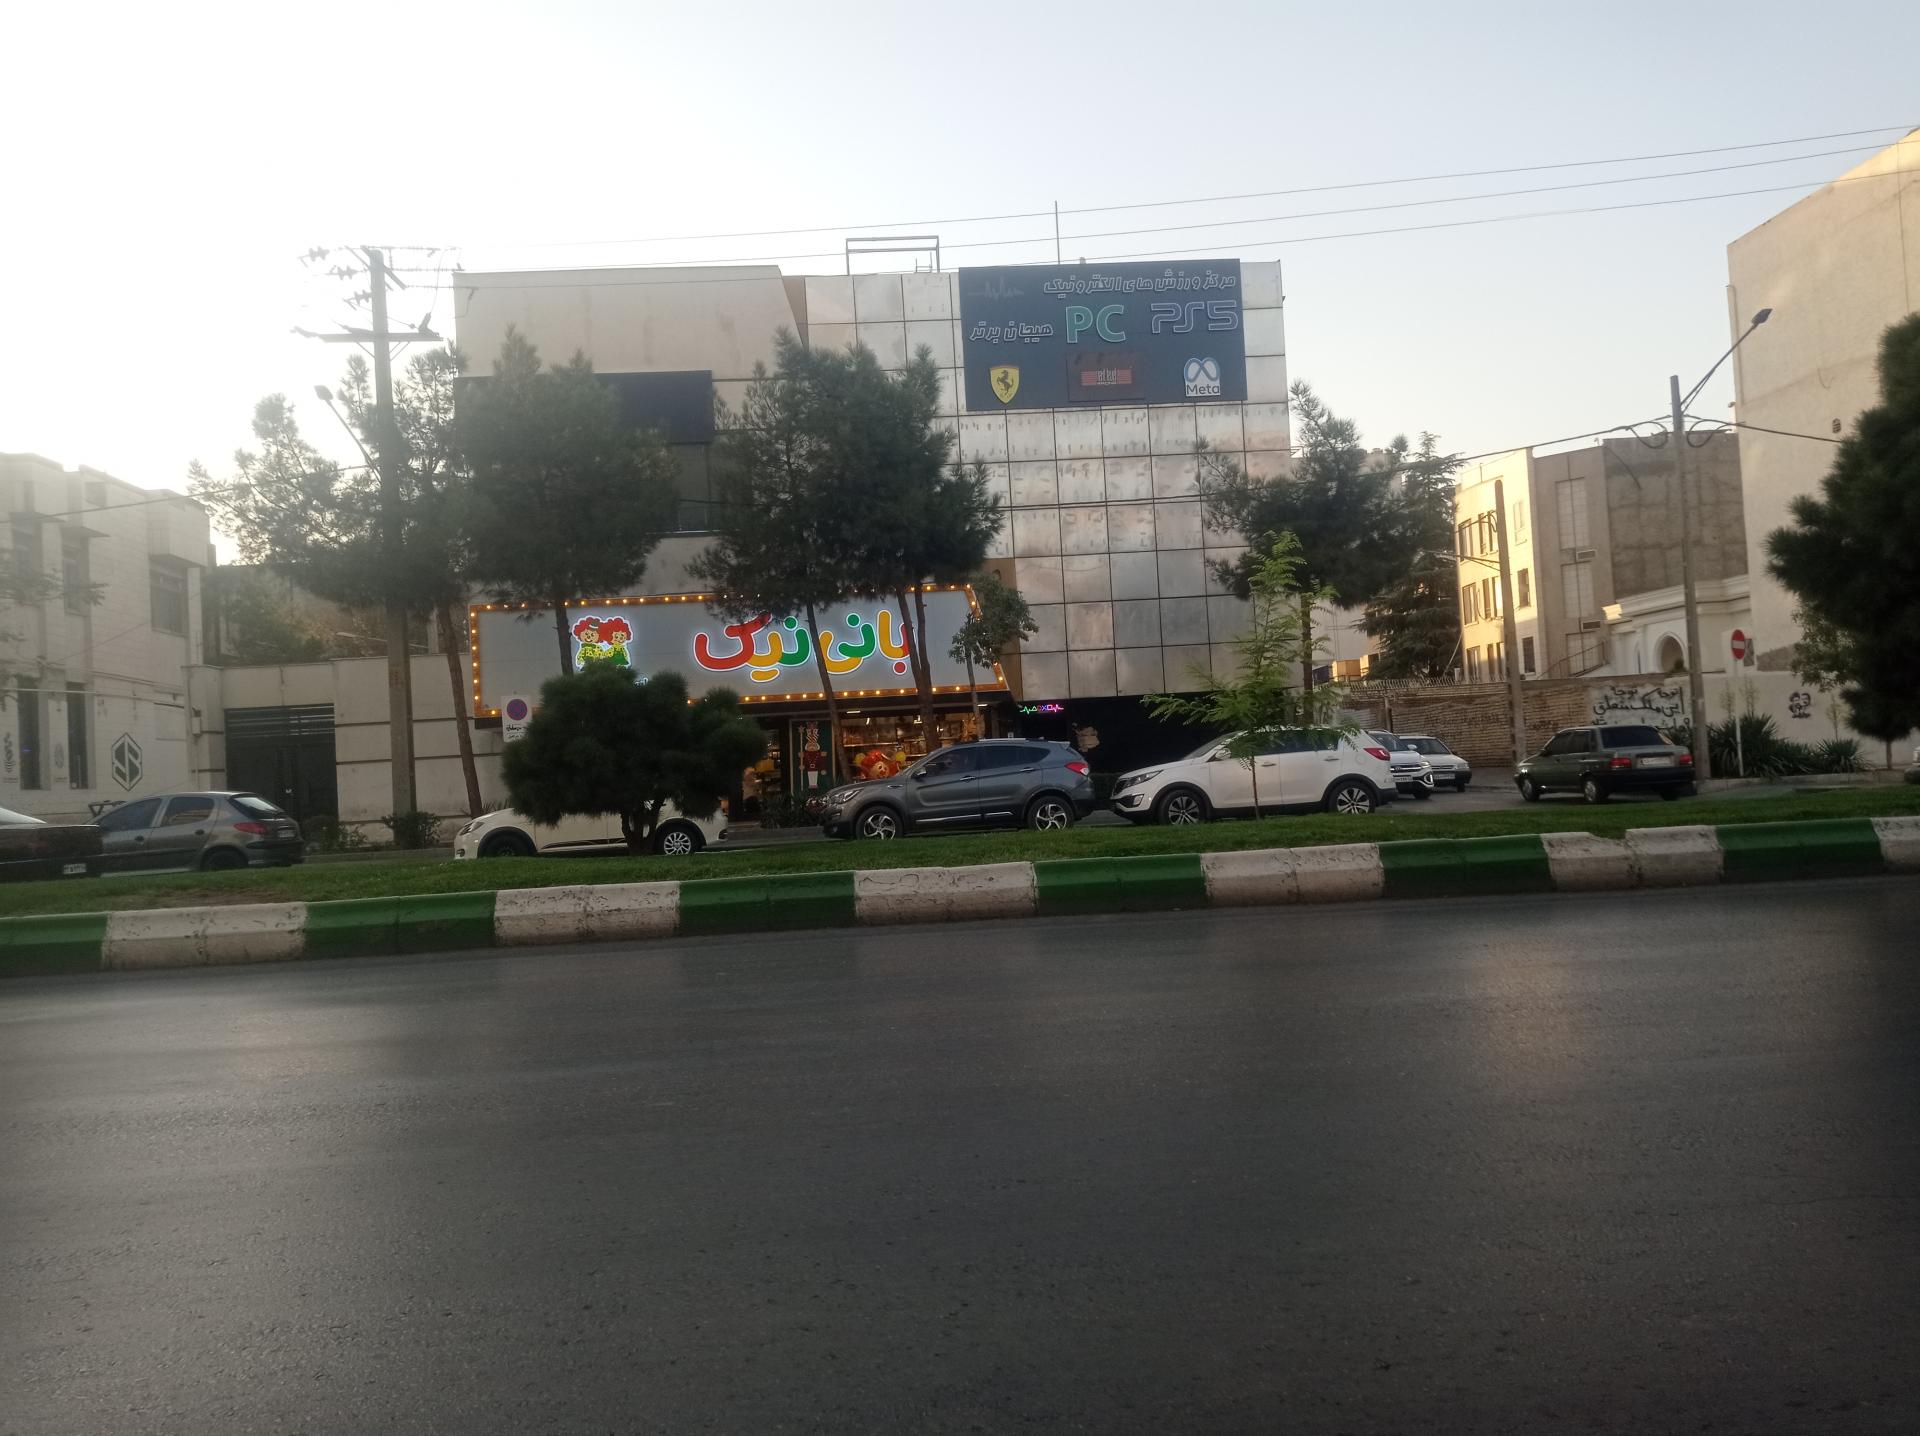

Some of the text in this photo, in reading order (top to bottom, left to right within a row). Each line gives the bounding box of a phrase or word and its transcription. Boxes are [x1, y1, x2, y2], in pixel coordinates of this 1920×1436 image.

[1043, 268, 1236, 299] مرکز ورزش های الکترونیک
[969, 320, 1053, 344] هیجان برتر
[1065, 300, 1239, 344] PC PS5
[1186, 383, 1220, 395] Meta
[693, 609, 911, 684] بانی نیک
